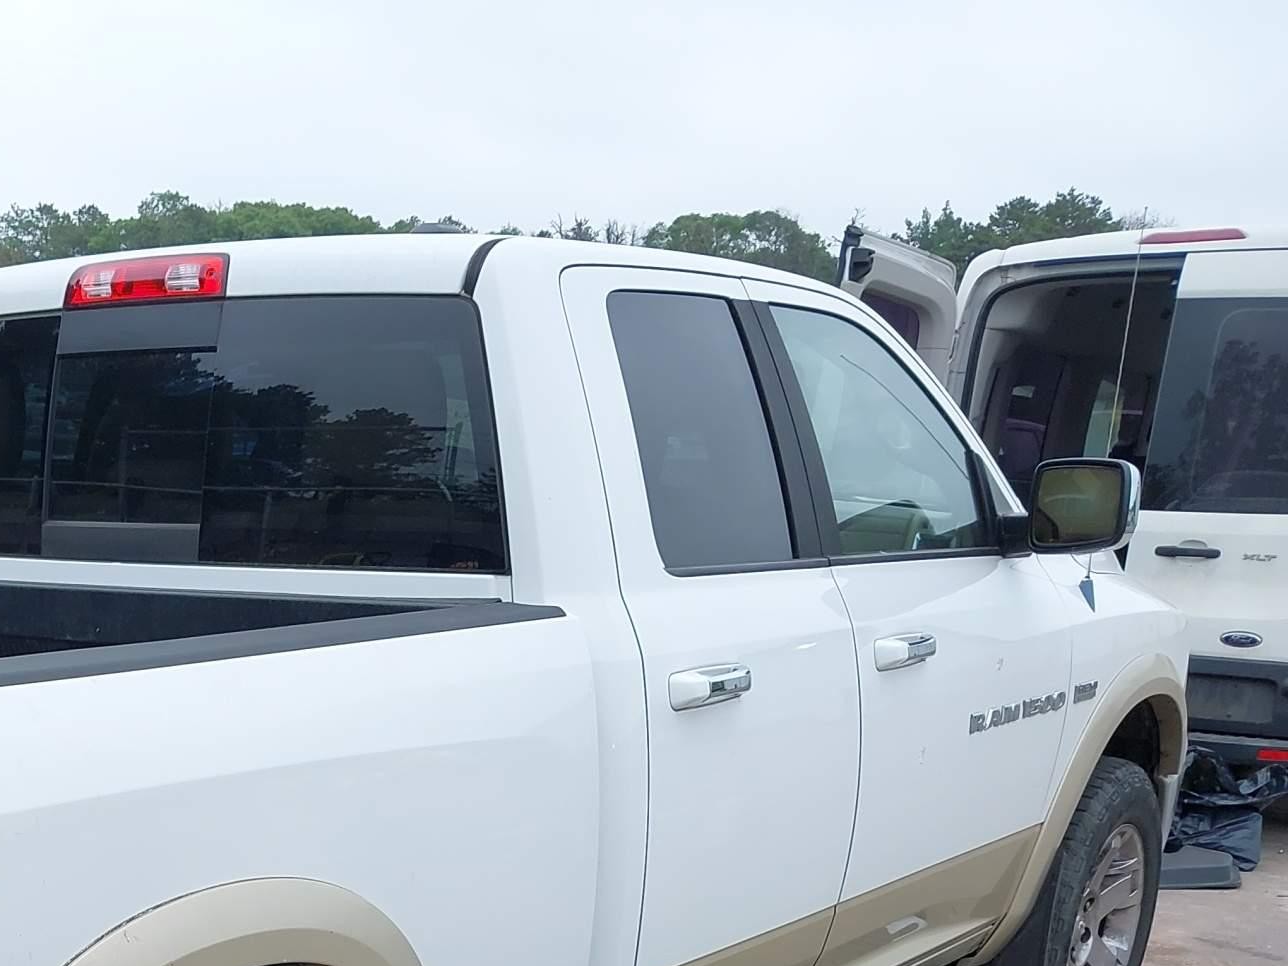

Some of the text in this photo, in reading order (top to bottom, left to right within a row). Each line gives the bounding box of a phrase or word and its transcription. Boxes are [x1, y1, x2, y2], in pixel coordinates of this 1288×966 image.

[1241, 553, 1278, 562] XLT
[969, 704, 1020, 735] RAM
[1022, 691, 1066, 719] 1500
